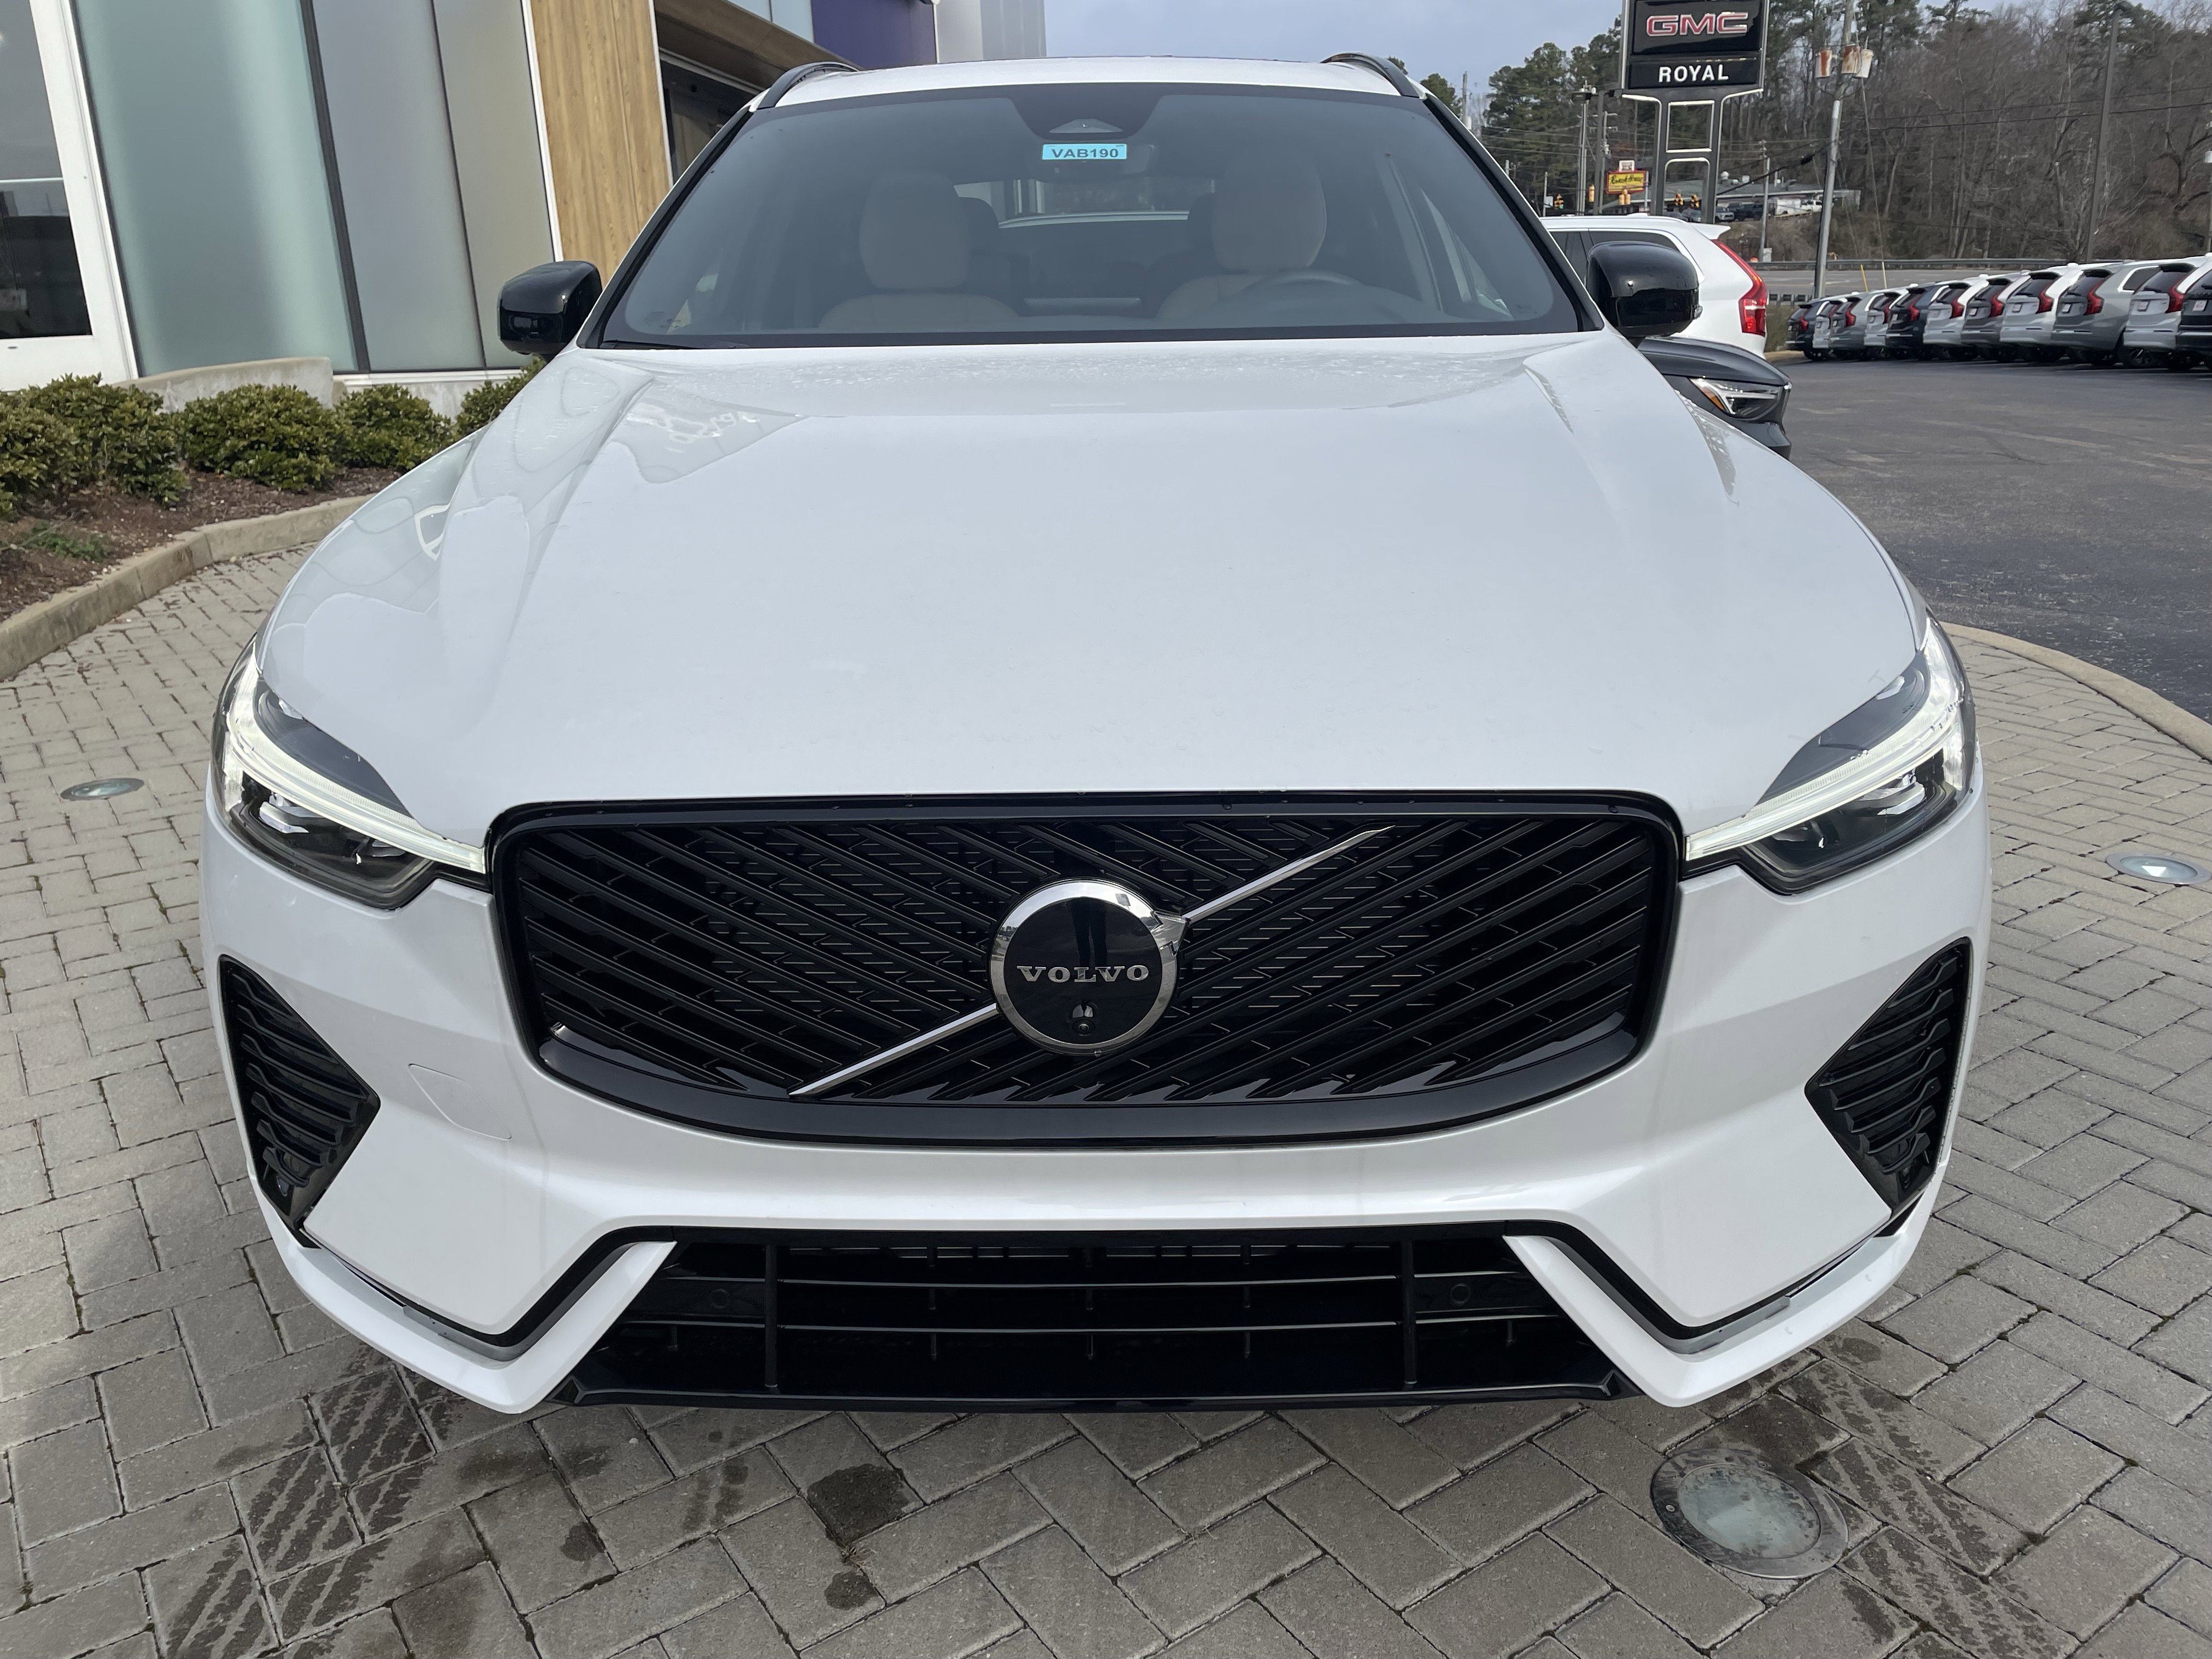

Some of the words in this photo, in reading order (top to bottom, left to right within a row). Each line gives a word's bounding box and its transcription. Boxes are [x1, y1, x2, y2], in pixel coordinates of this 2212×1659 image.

[1646, 12, 1748, 36] GMC
[1658, 64, 1729, 83] ROYAL
[1052, 149, 1119, 158] VAB190
[1017, 965, 1149, 983] VOLVO
